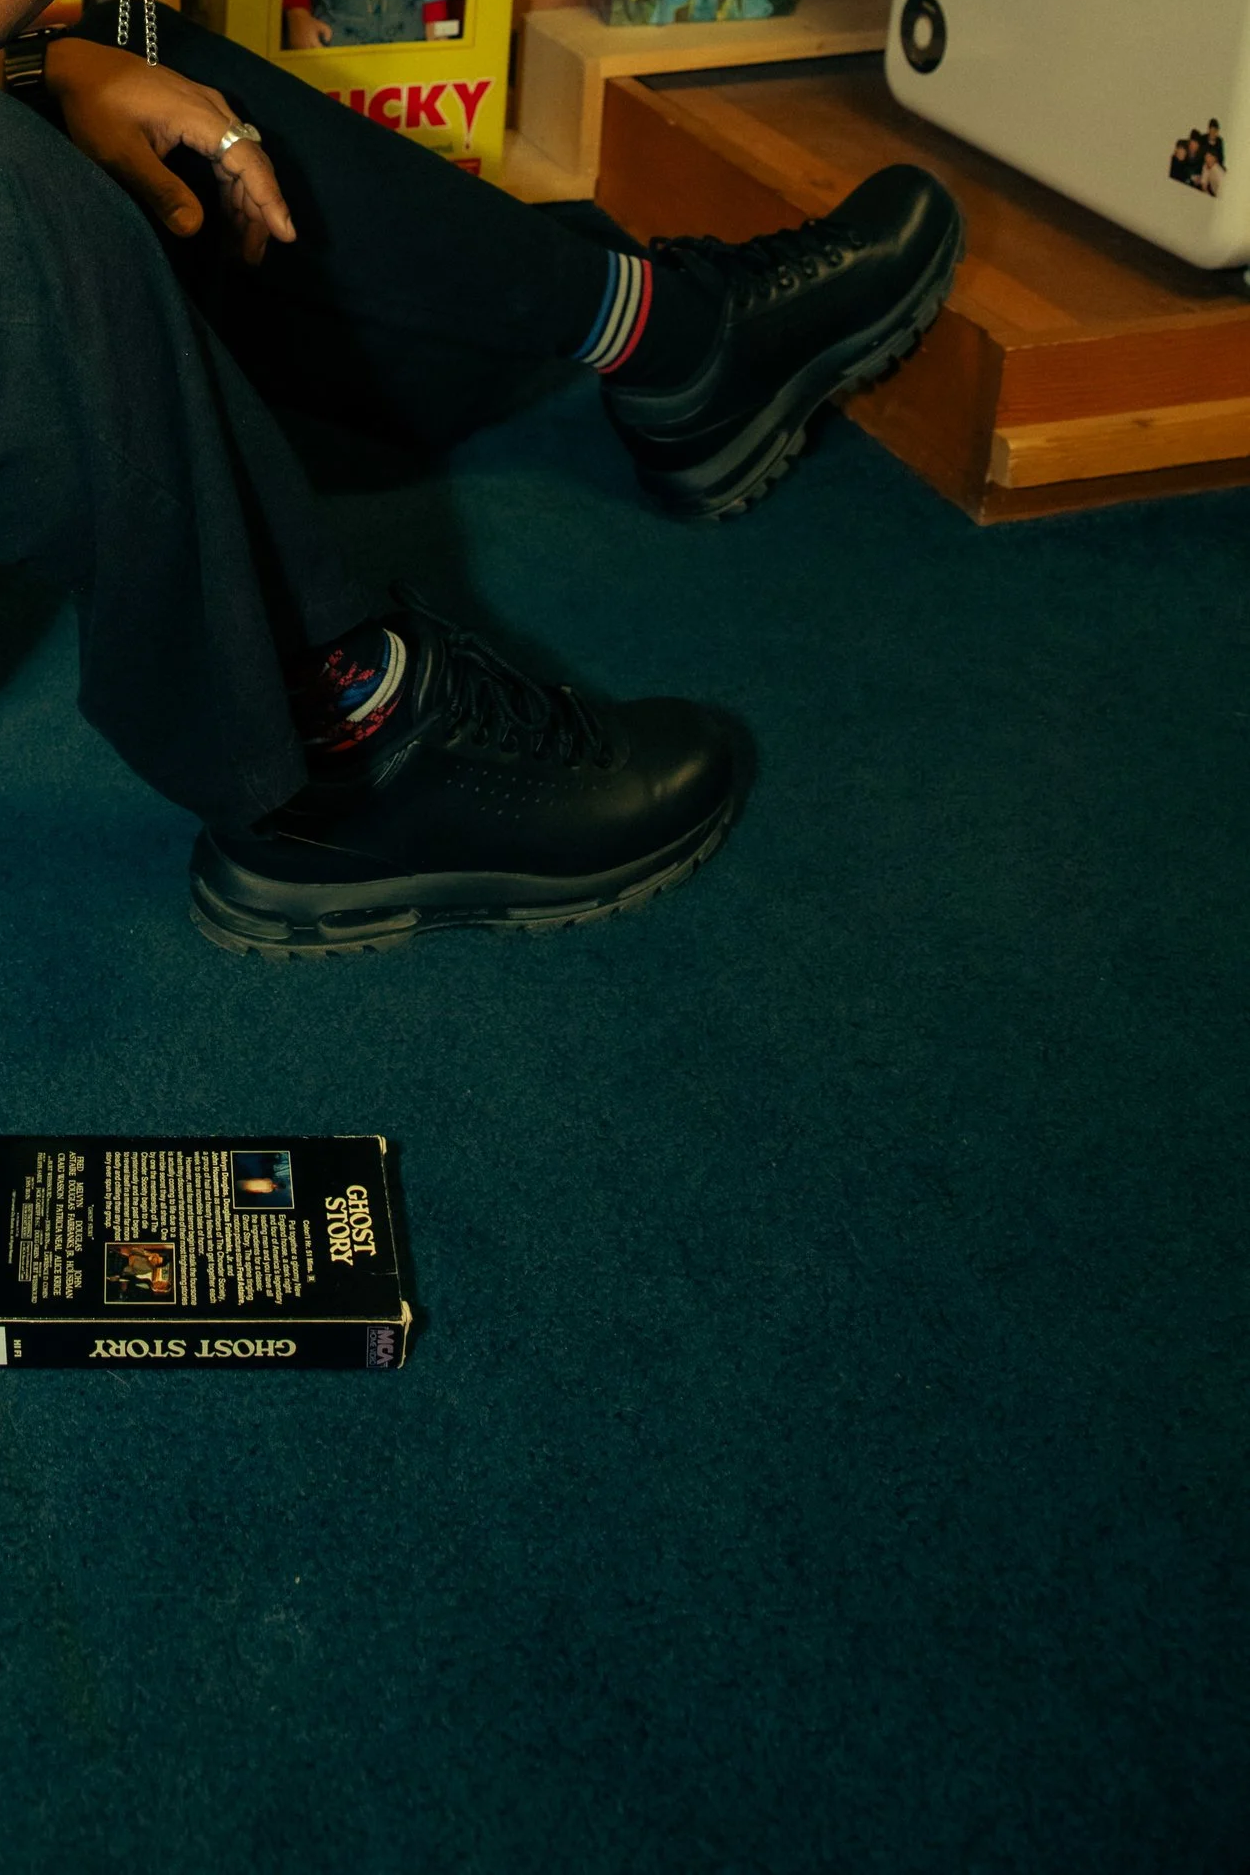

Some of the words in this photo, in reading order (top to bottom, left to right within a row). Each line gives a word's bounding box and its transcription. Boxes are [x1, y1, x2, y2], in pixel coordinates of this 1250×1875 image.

[57, 1152, 65, 1172] CRAIG
[68, 1150, 76, 1176] ASTAIRE
[75, 1156, 84, 1171] FRED
[56, 1173, 64, 1199] WASSON
[67, 1179, 76, 1210] DOUGLAS
[75, 1181, 83, 1207] MELVYN
[55, 1203, 63, 1233] PATRICIA
[346, 1184, 374, 1253] GHOST
[66, 1213, 75, 1248] FAIRBANKS,
[74, 1220, 83, 1251] DOUGLAS
[325, 1196, 353, 1265] STORY
[54, 1234, 62, 1251] NEAL
[288, 1230, 297, 1254] together
[53, 1254, 62, 1274] ALICE
[64, 1249, 74, 1258] JR.
[65, 1260, 74, 1298] HOUSEMAN
[73, 1269, 82, 1287] JOHN
[290, 1260, 299, 1282] gloomy
[52, 1275, 61, 1295] KRIGE
[13, 1338, 22, 1348] HI
[368, 1329, 377, 1345] HOME
[377, 1328, 395, 1365] MCA
[13, 1349, 22, 1358] FI
[89, 1338, 187, 1358] STORY
[194, 1338, 297, 1358] GHOST
[368, 1346, 377, 1366] VIDEO
